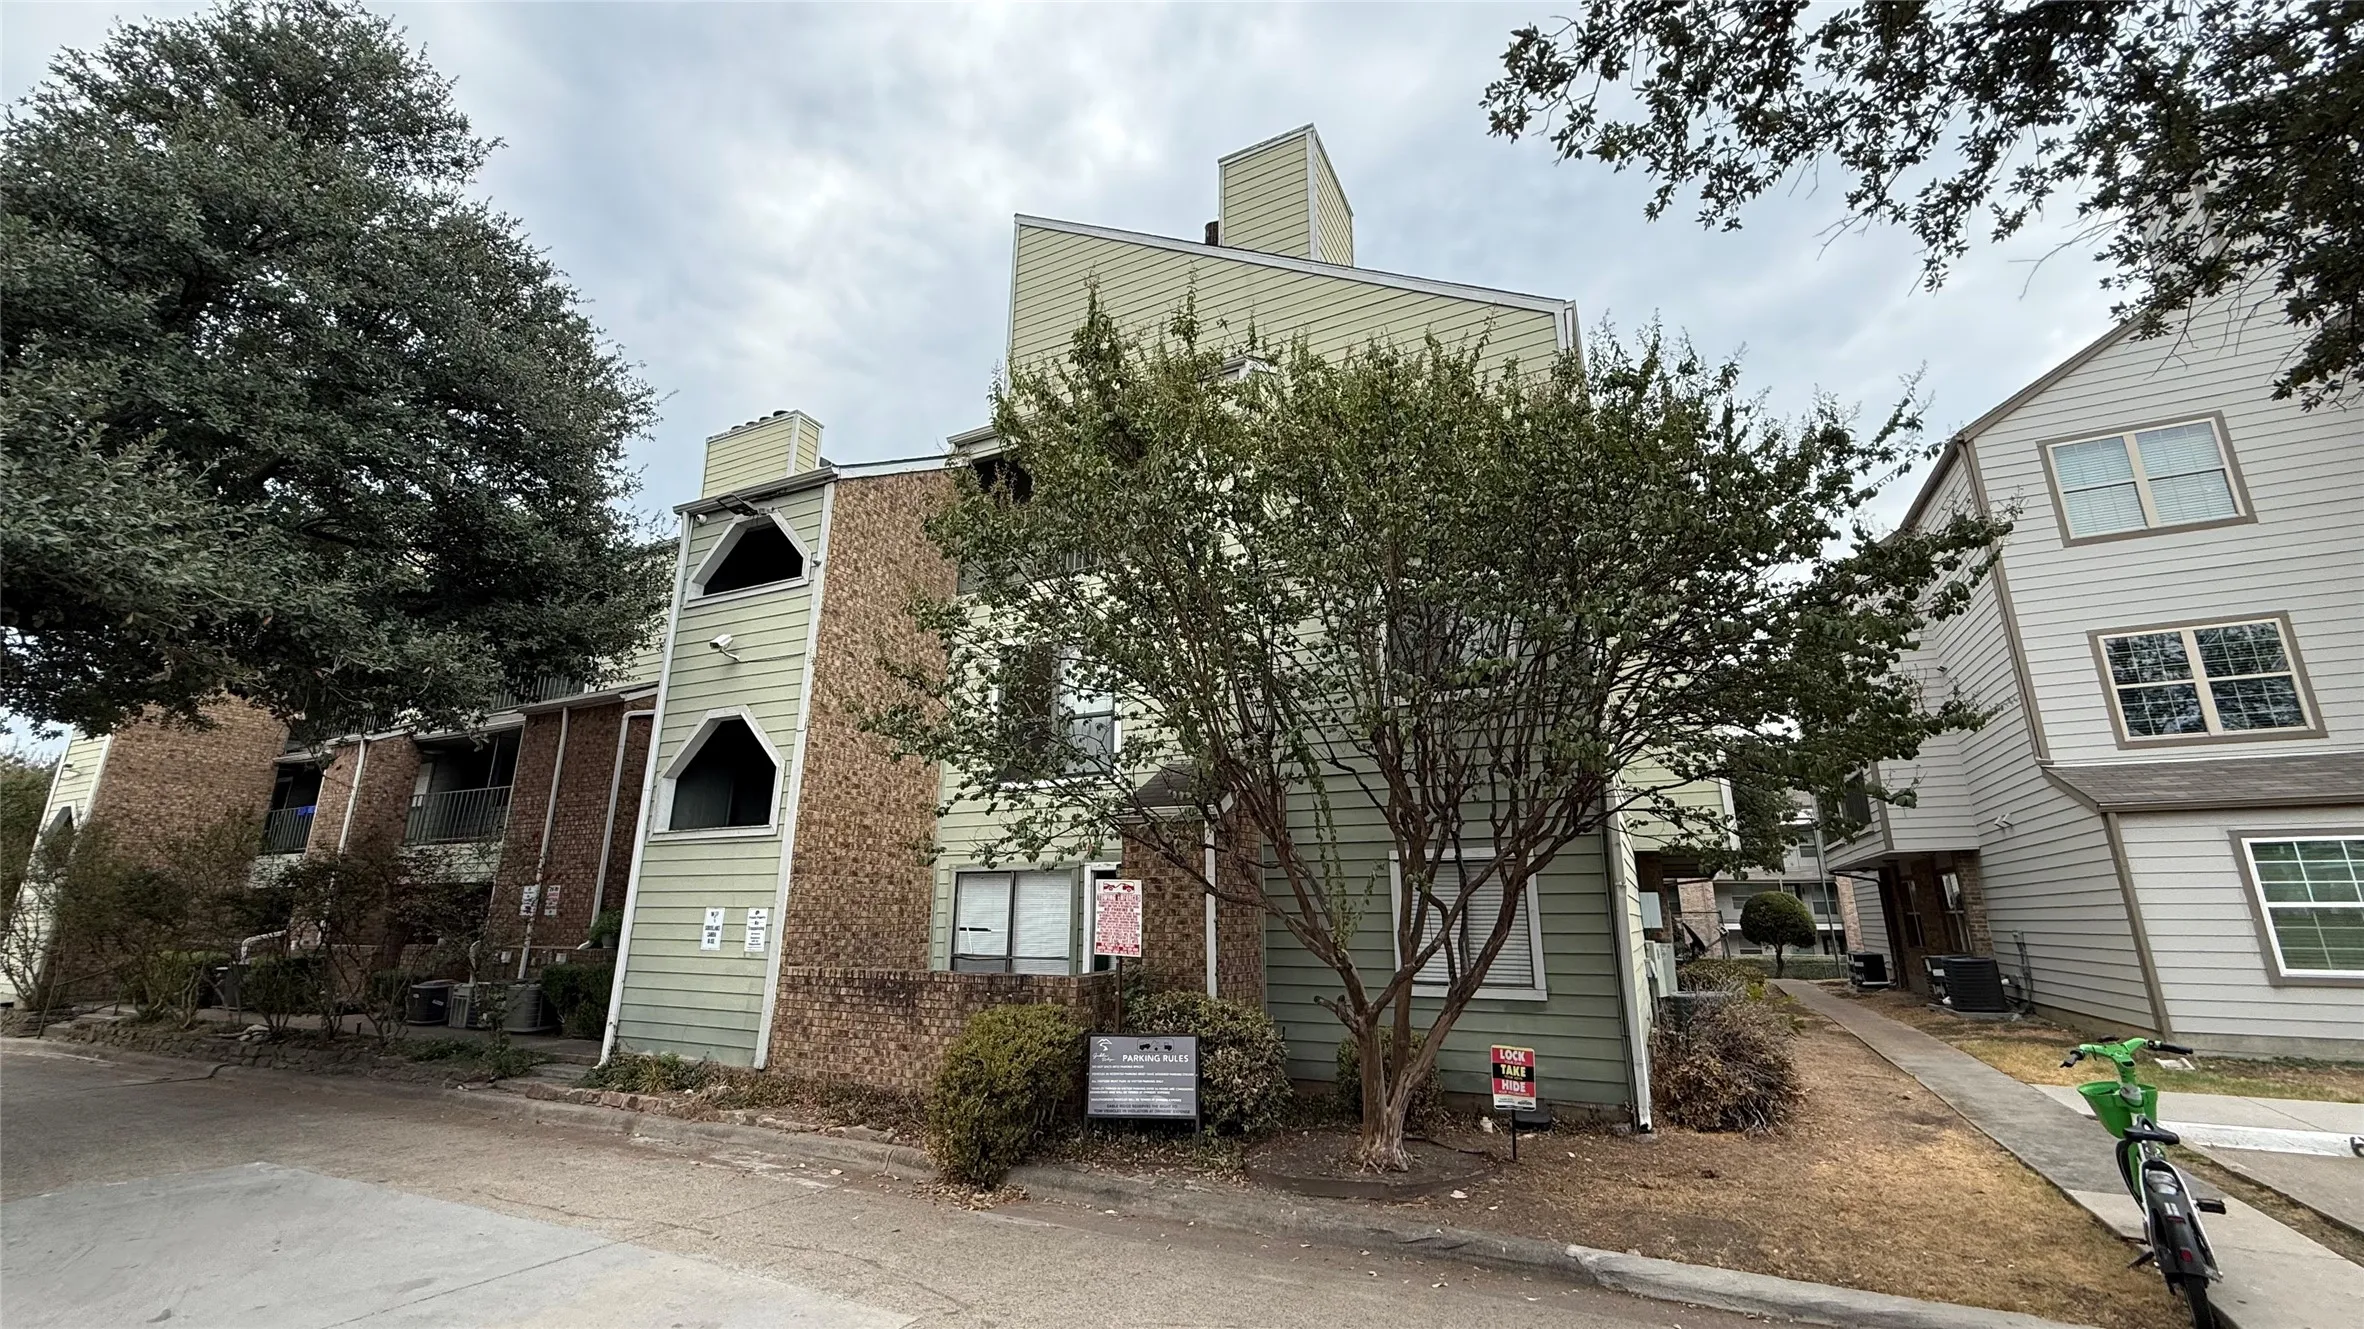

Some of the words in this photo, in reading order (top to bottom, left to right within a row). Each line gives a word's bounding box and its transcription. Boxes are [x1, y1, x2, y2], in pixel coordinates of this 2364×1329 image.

[1122, 1054, 1161, 1063] PARKING
[1162, 1054, 1189, 1063] RULES
[1500, 1049, 1525, 1062] LOCK
[1500, 1064, 1526, 1078] TAKE
[1501, 1079, 1526, 1093] HIDE
